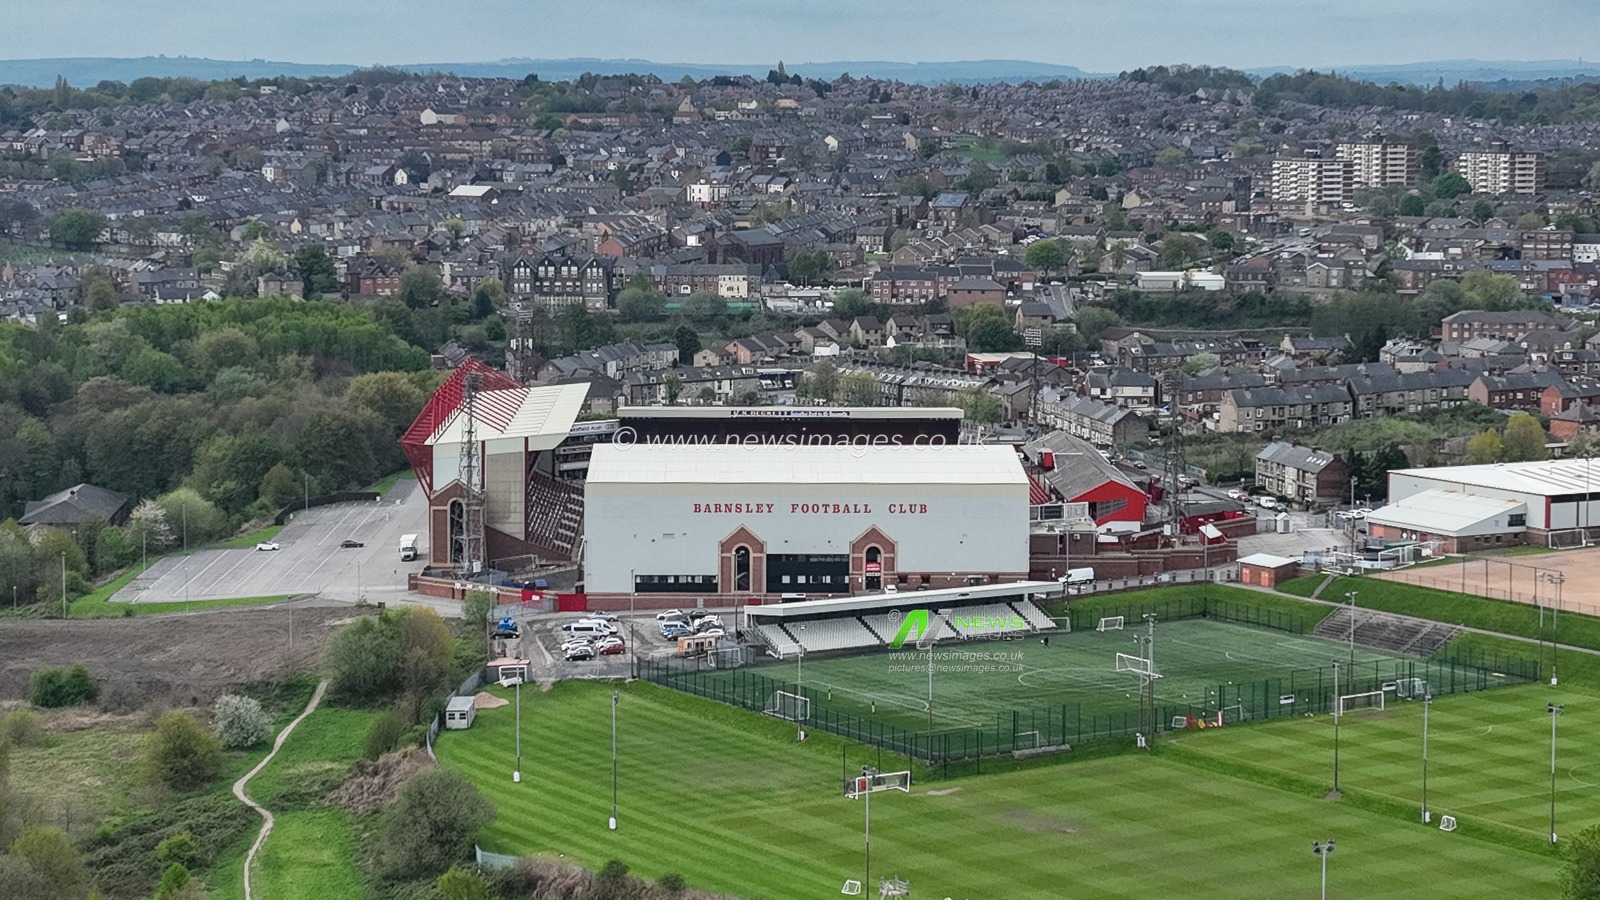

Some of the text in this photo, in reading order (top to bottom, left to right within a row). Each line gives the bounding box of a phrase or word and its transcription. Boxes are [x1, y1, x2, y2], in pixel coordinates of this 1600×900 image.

[693, 503, 928, 514] BARNSLEY FOOTBALL CLUB
